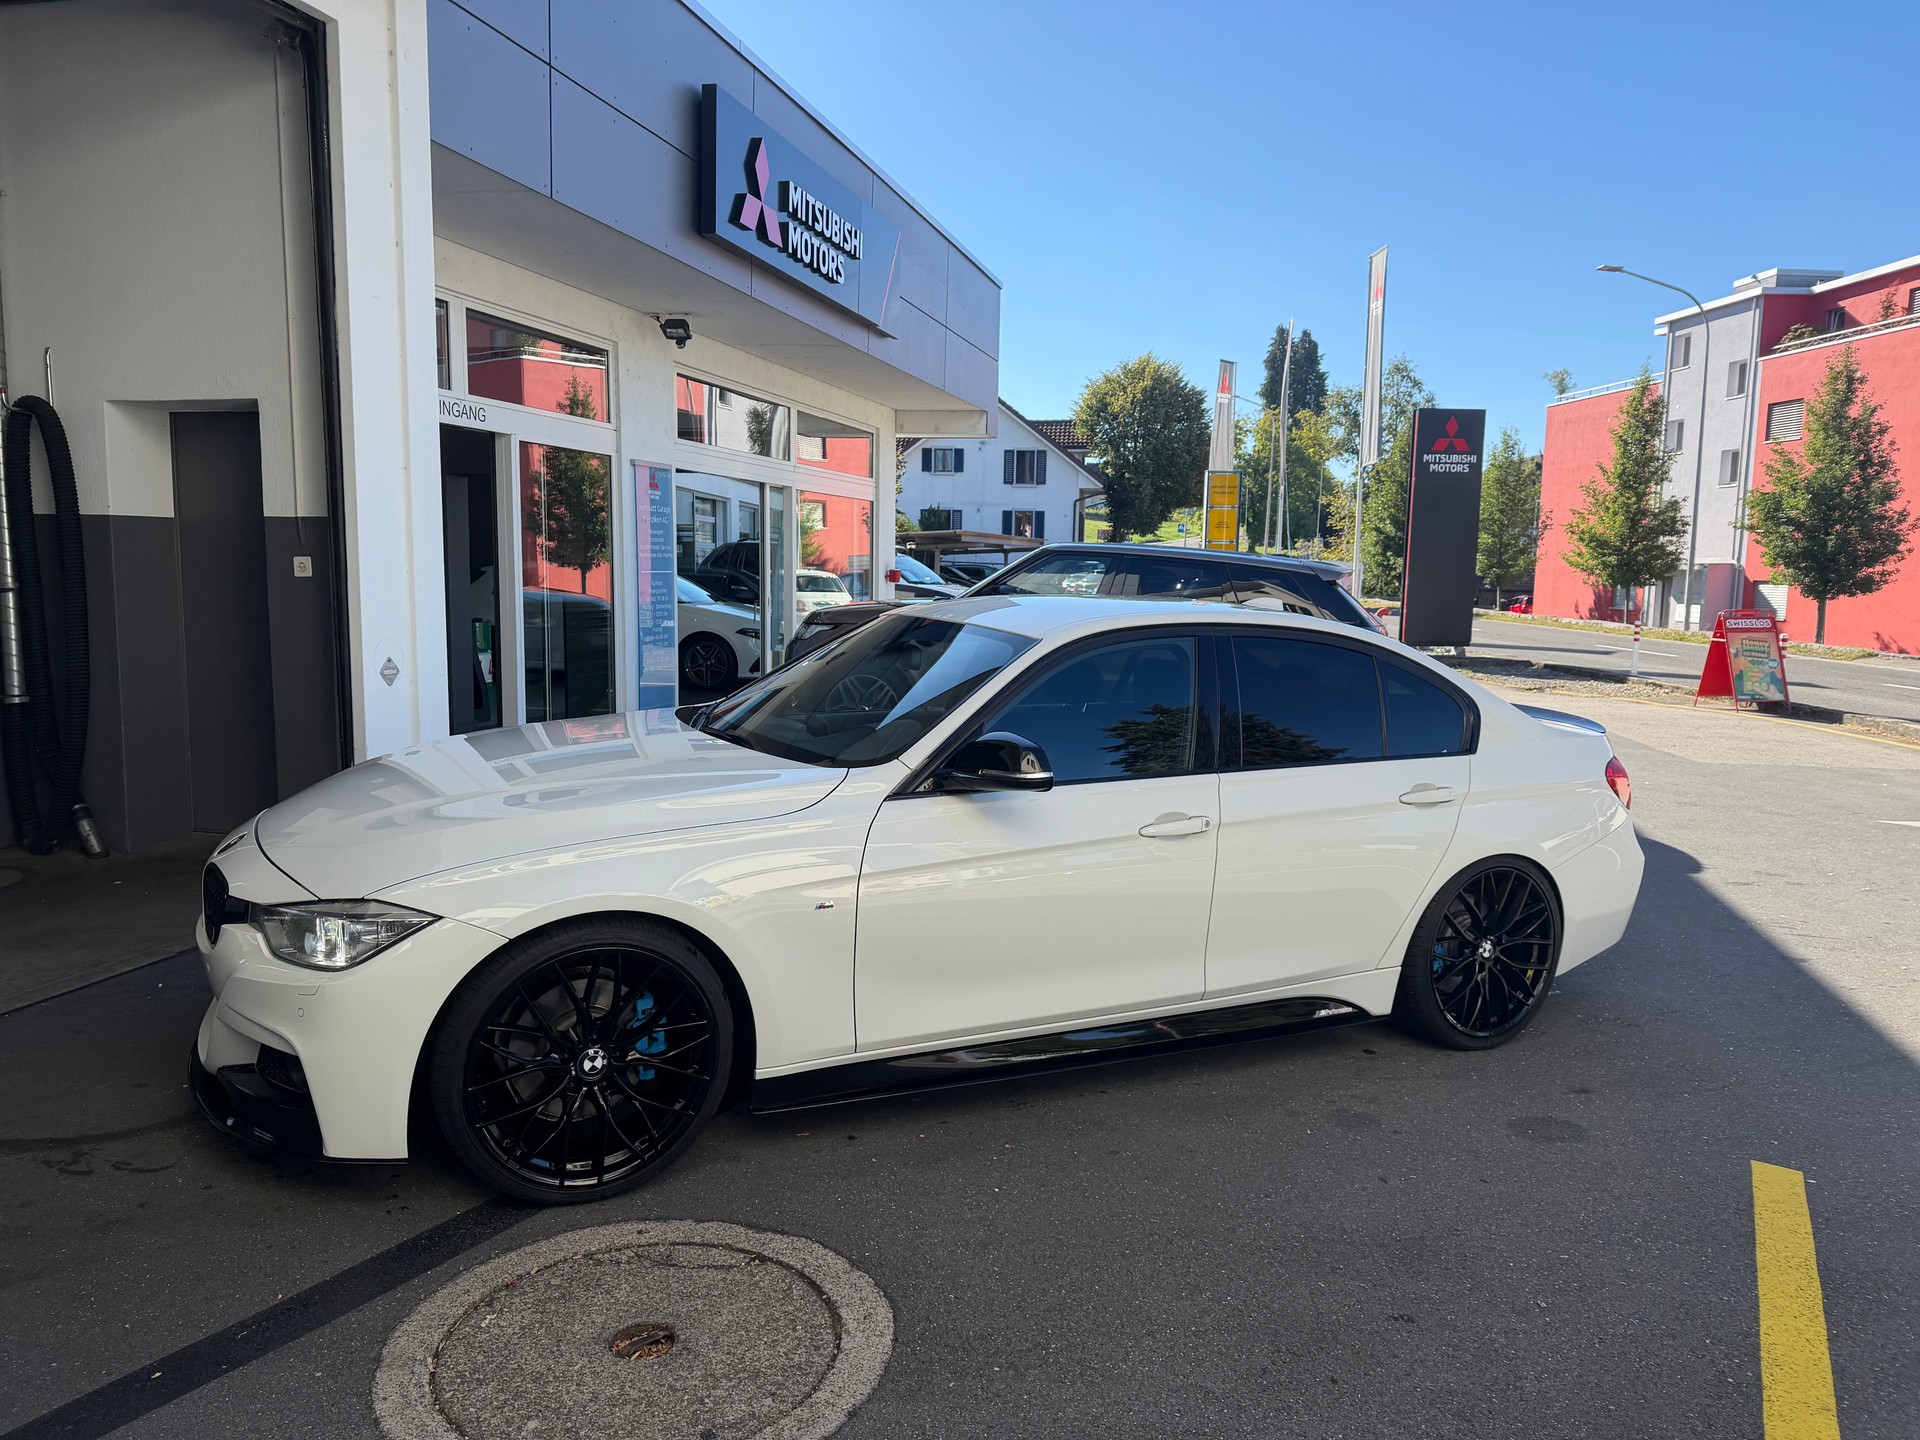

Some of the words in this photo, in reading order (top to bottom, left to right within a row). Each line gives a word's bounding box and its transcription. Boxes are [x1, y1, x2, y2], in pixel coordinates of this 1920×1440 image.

[788, 180, 864, 260] MITSUBISHI
[788, 221, 845, 285] MOTORS
[439, 399, 486, 422] INGANG
[1423, 454, 1477, 463] MITSUBISHI
[1429, 464, 1470, 473] MOTORS
[1727, 619, 1771, 628] SWISSLOS
